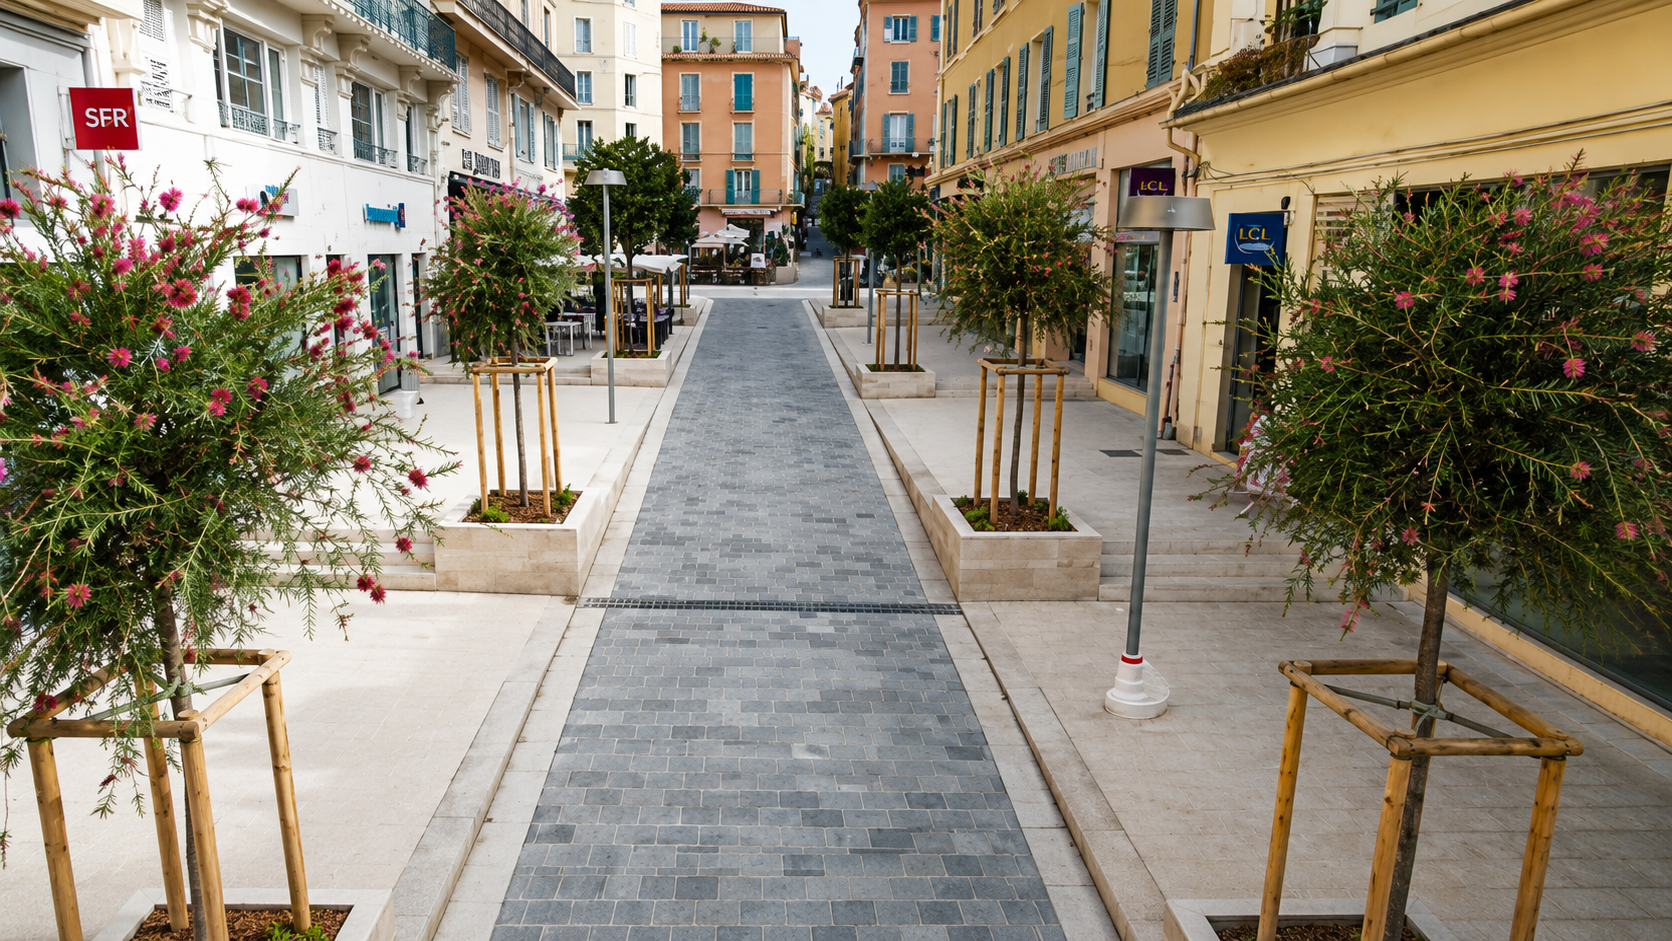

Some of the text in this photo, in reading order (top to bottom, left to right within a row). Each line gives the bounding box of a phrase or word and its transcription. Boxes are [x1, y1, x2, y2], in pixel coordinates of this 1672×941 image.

[85, 107, 130, 128] SFR
[1140, 180, 1168, 191] LCL
[1239, 227, 1271, 240] LCL
